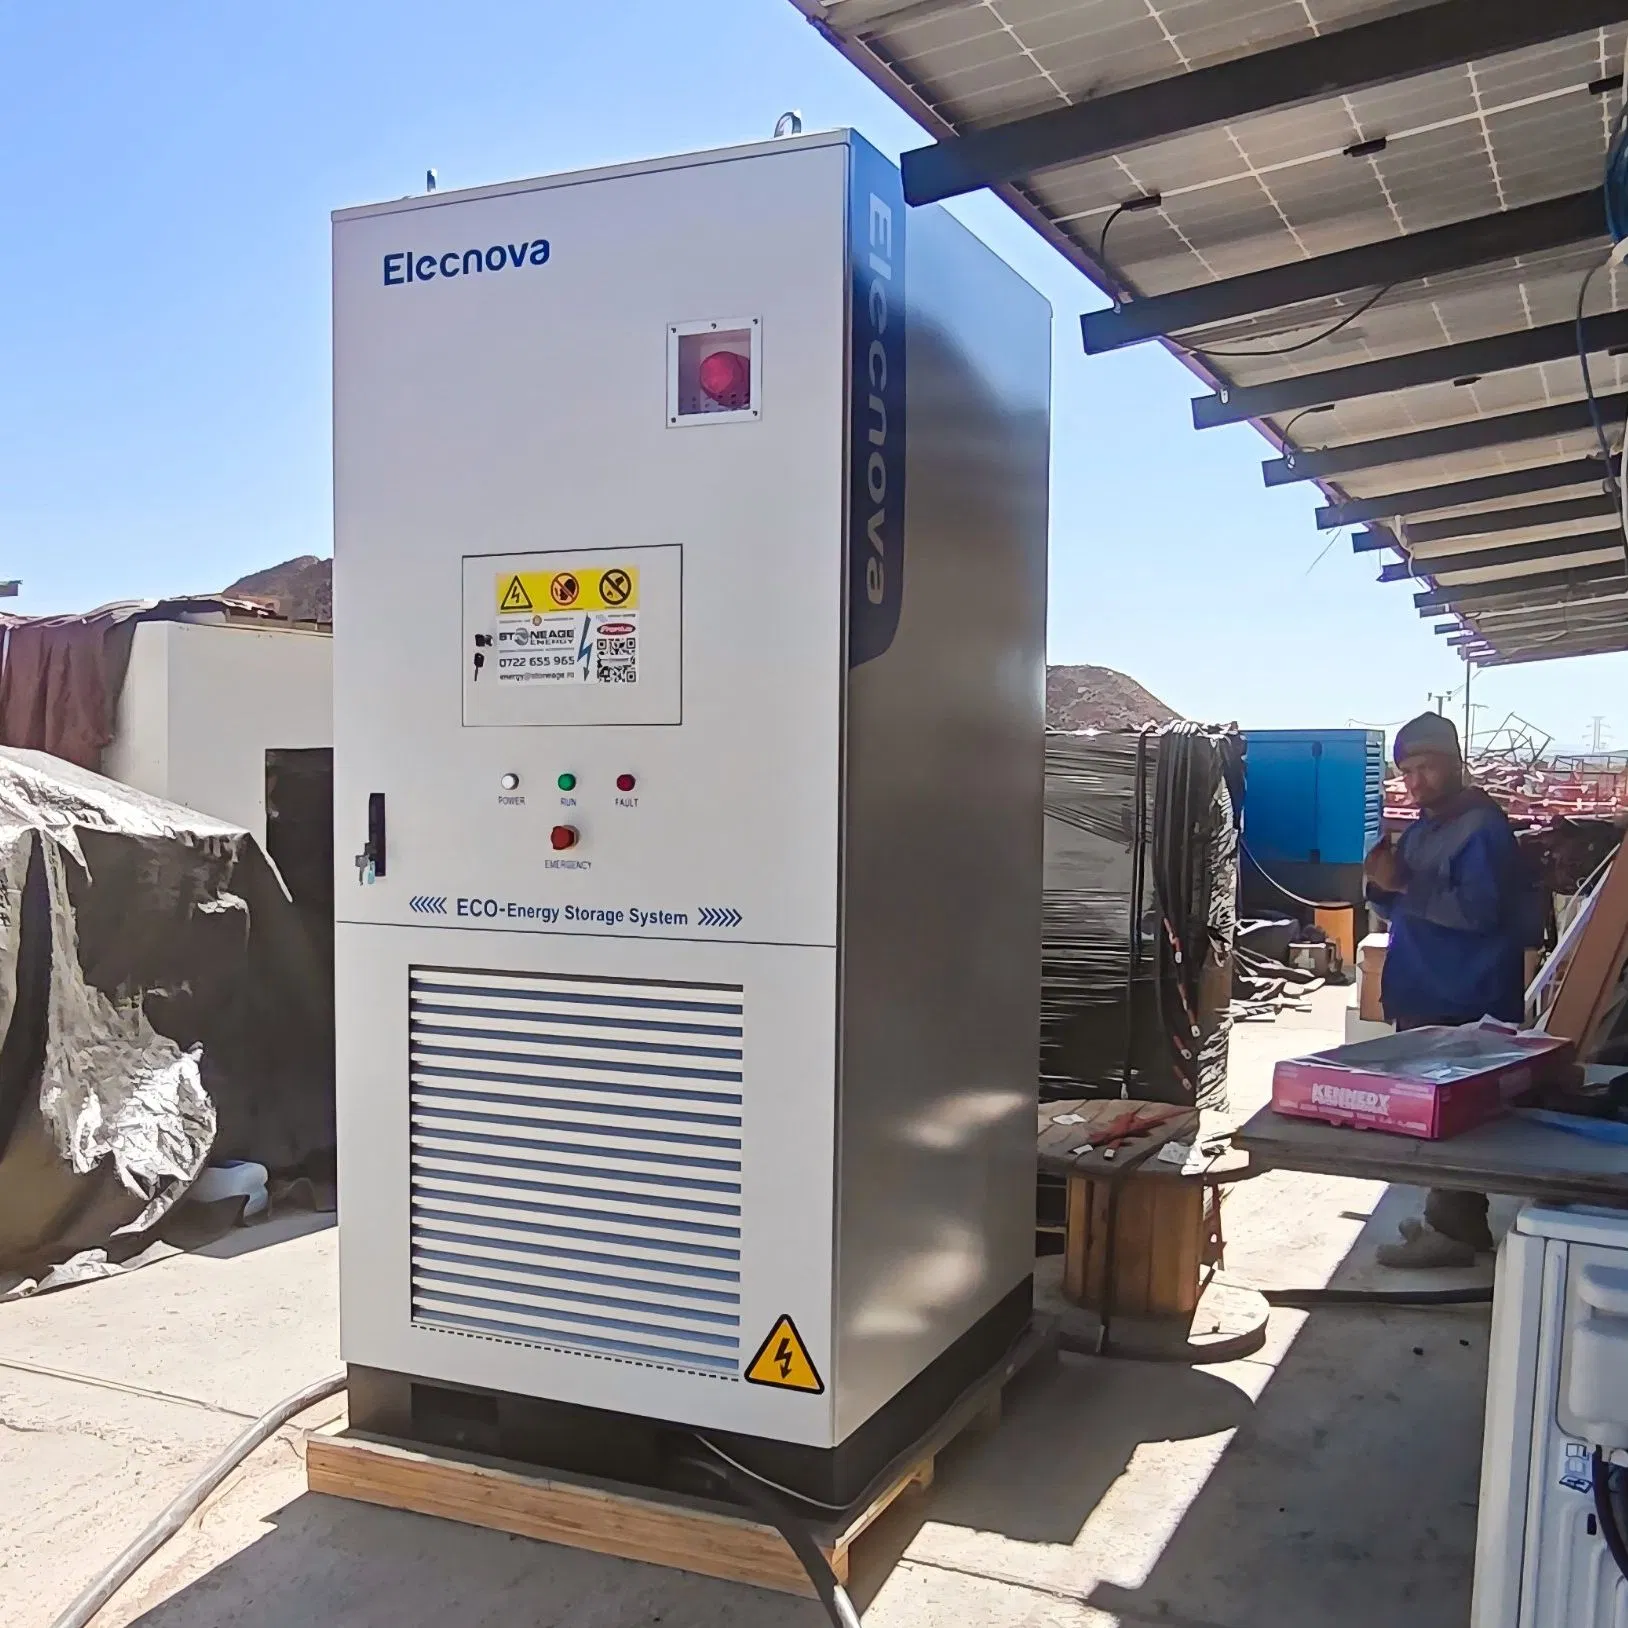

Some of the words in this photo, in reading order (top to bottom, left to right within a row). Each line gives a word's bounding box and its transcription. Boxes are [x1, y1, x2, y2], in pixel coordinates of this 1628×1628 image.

[383, 238, 550, 286] Elecnova
[866, 192, 892, 605] Elecnova
[499, 657, 526, 668] 0722
[529, 656, 551, 666] 655
[553, 655, 575, 665] 965
[498, 796, 526, 806] POWER
[560, 797, 577, 807] RUN
[615, 798, 639, 808] FAULT
[544, 859, 592, 870] EMERGENCY
[456, 898, 560, 924] ECO-Energy
[564, 905, 624, 926] Storage
[629, 908, 689, 927] System
